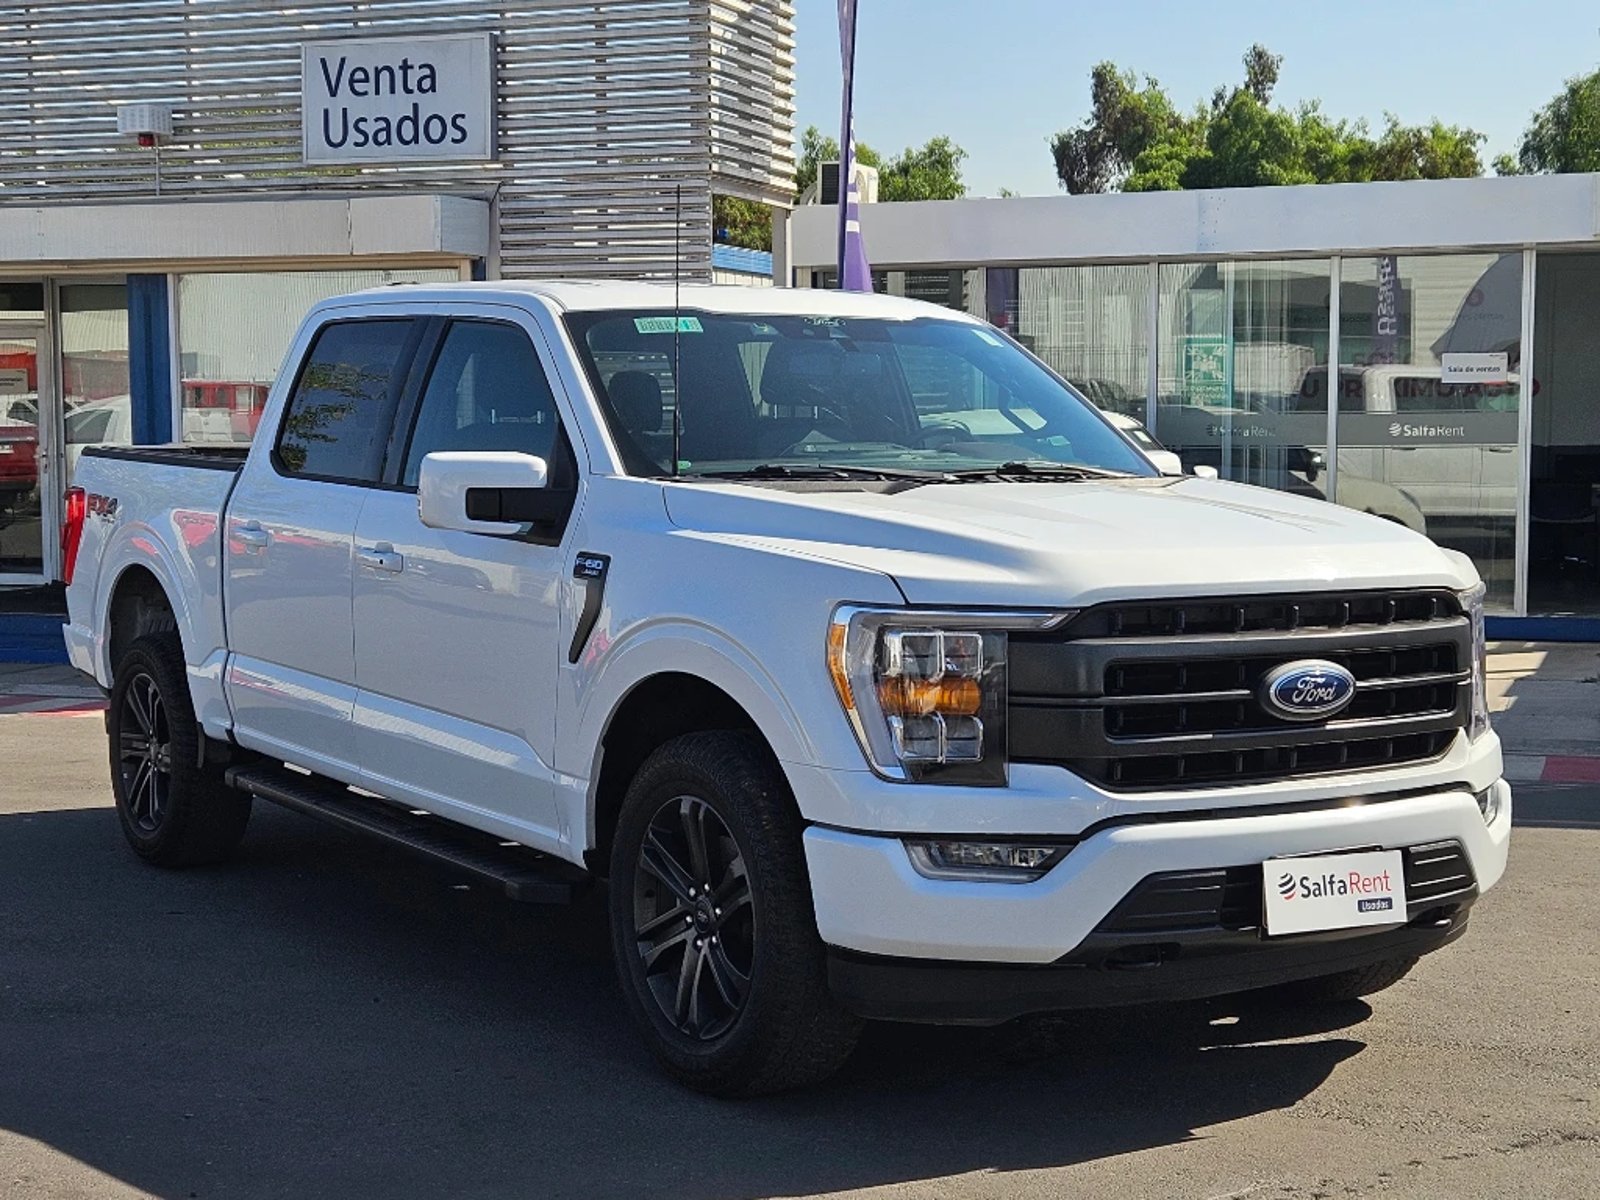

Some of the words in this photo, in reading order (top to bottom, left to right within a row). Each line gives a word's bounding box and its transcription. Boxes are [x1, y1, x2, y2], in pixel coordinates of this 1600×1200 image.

[320, 56, 437, 98] Venta
[323, 102, 468, 148] Usados
[1448, 365, 1463, 373] Sala
[1465, 365, 1474, 373] de
[1403, 424, 1465, 438] SalfaRent
[1292, 676, 1338, 704] Ford
[1300, 869, 1391, 899] SalfaRent
[1361, 899, 1390, 912] Usados
